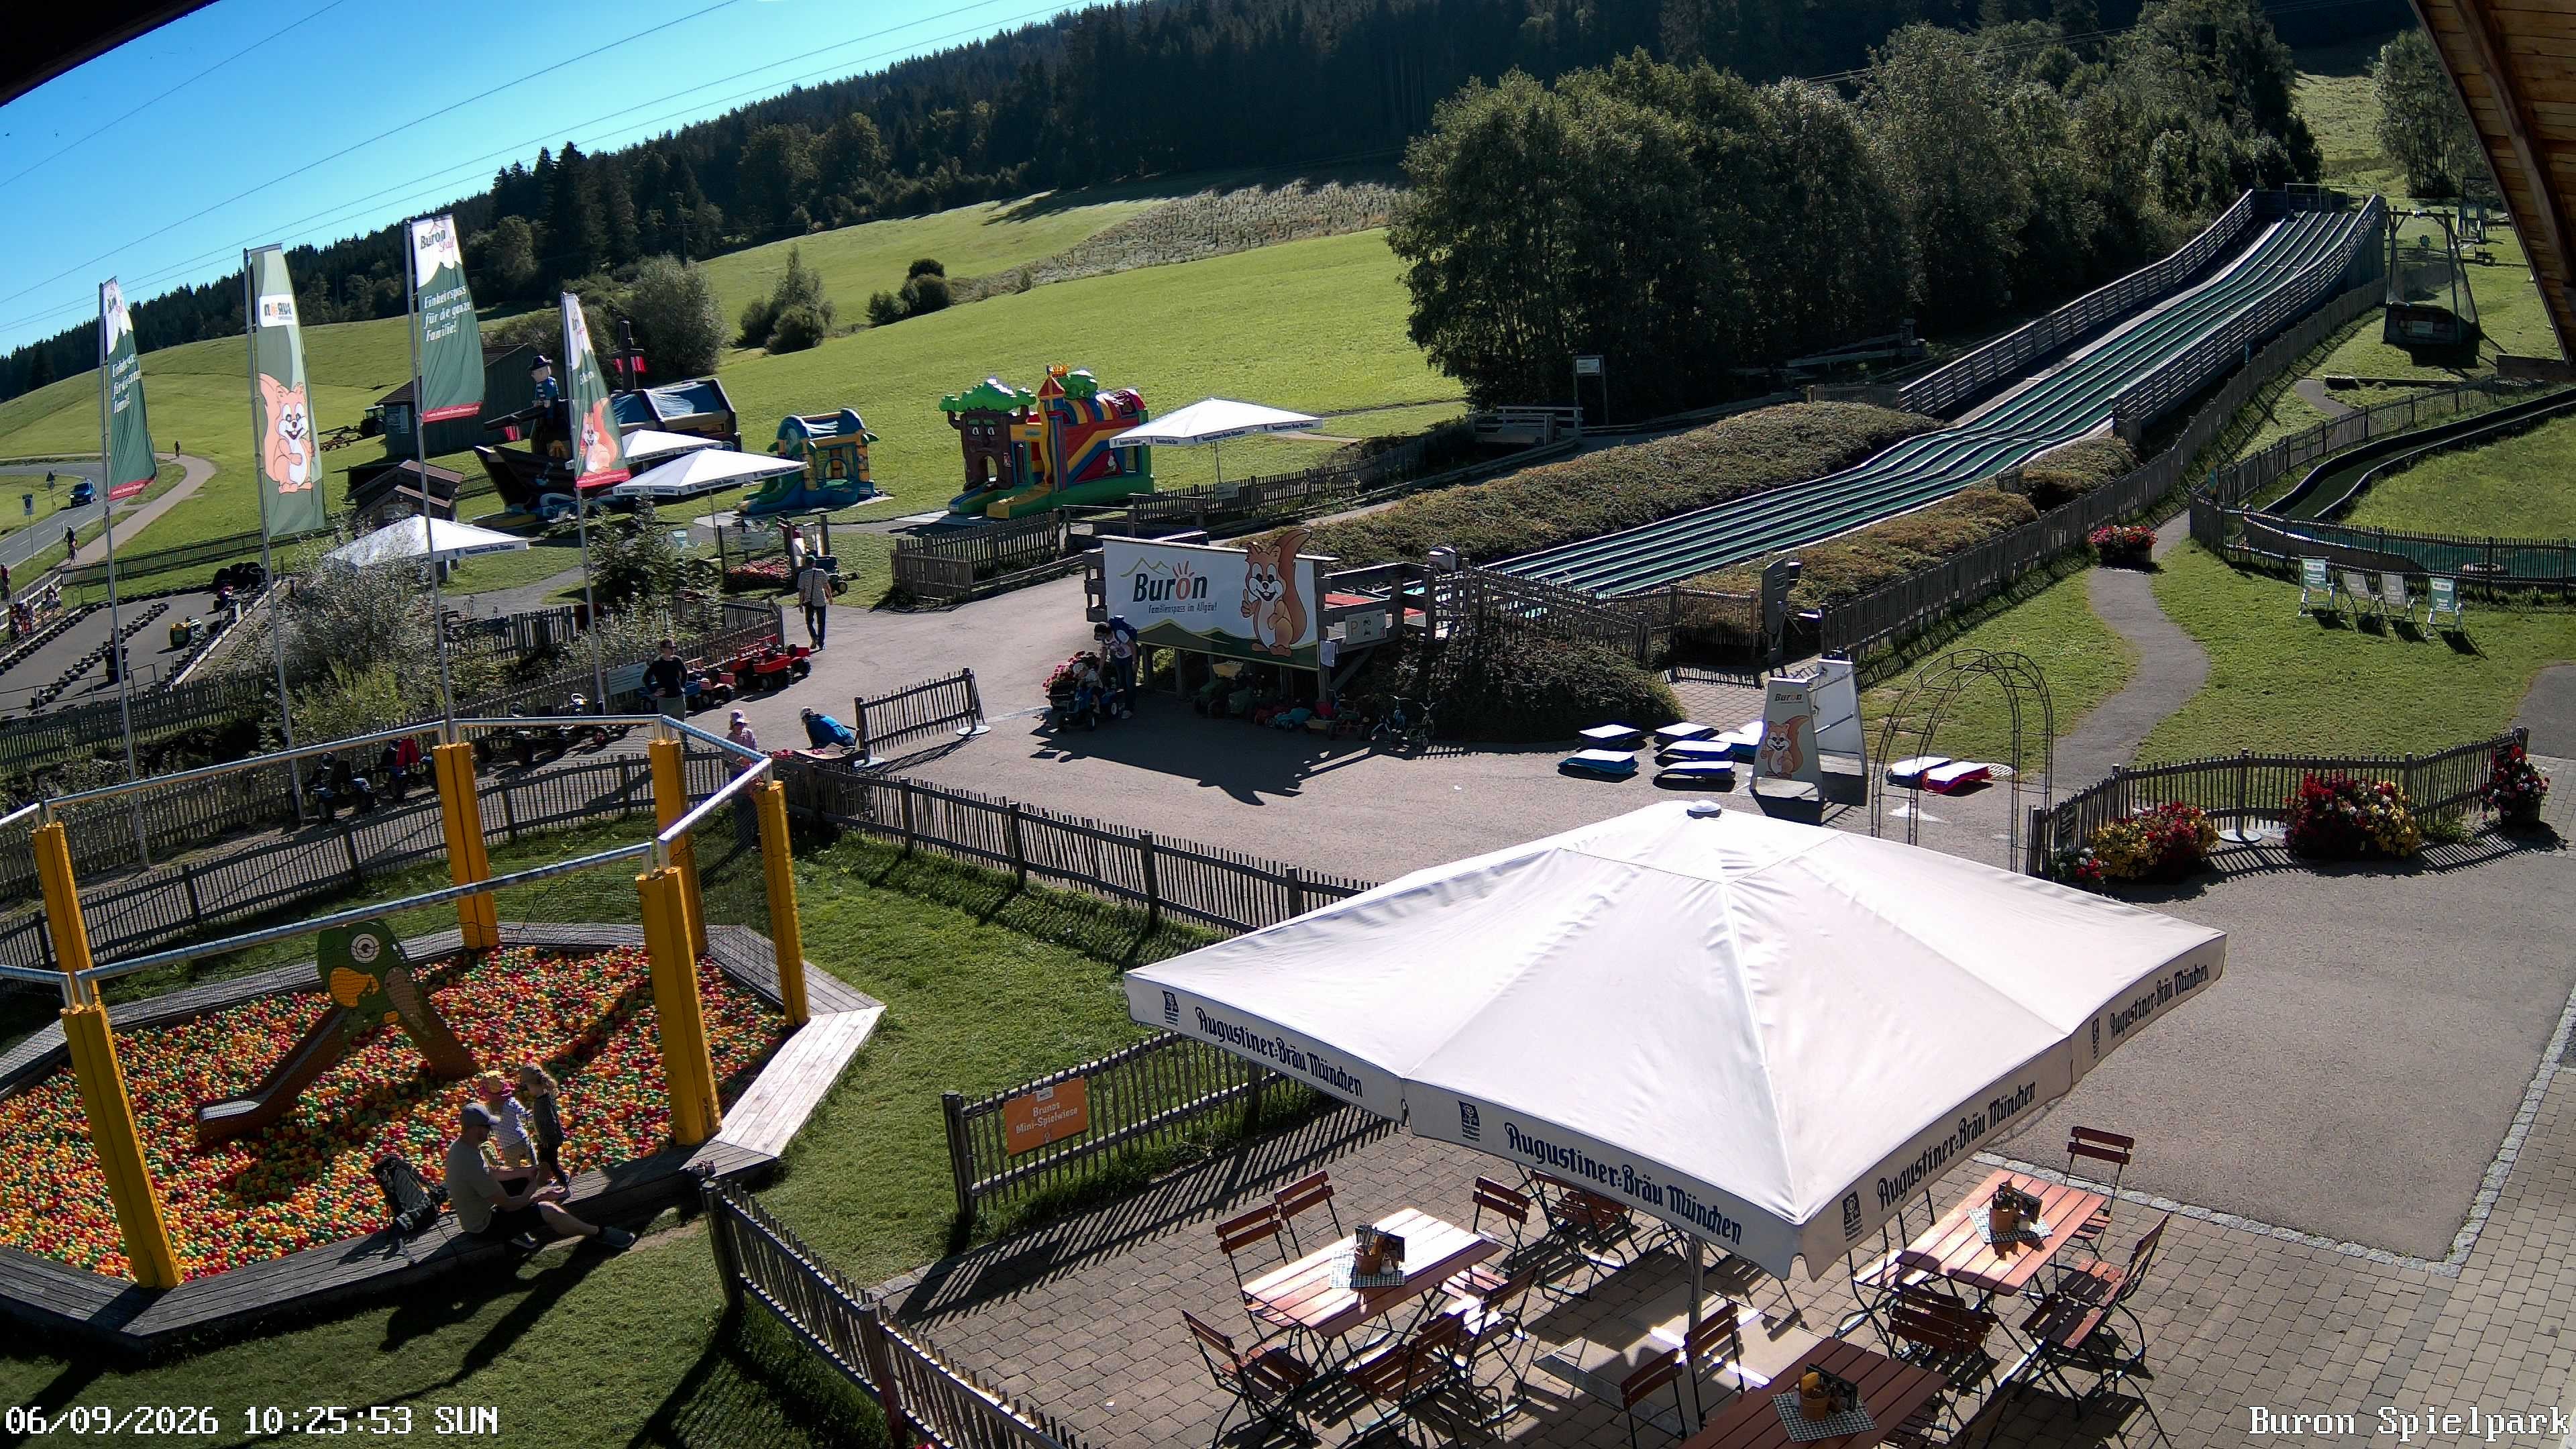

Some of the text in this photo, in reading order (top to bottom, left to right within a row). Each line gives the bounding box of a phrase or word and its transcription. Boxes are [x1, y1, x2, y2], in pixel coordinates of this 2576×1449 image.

[1132, 573, 1208, 602] Buron
[2174, 963, 2209, 996] München
[1307, 1051, 1363, 1098] München
[1016, 1107, 1078, 1134] Mini-Spielwiese
[1988, 1081, 2036, 1130] München
[1666, 1184, 1743, 1246] München
